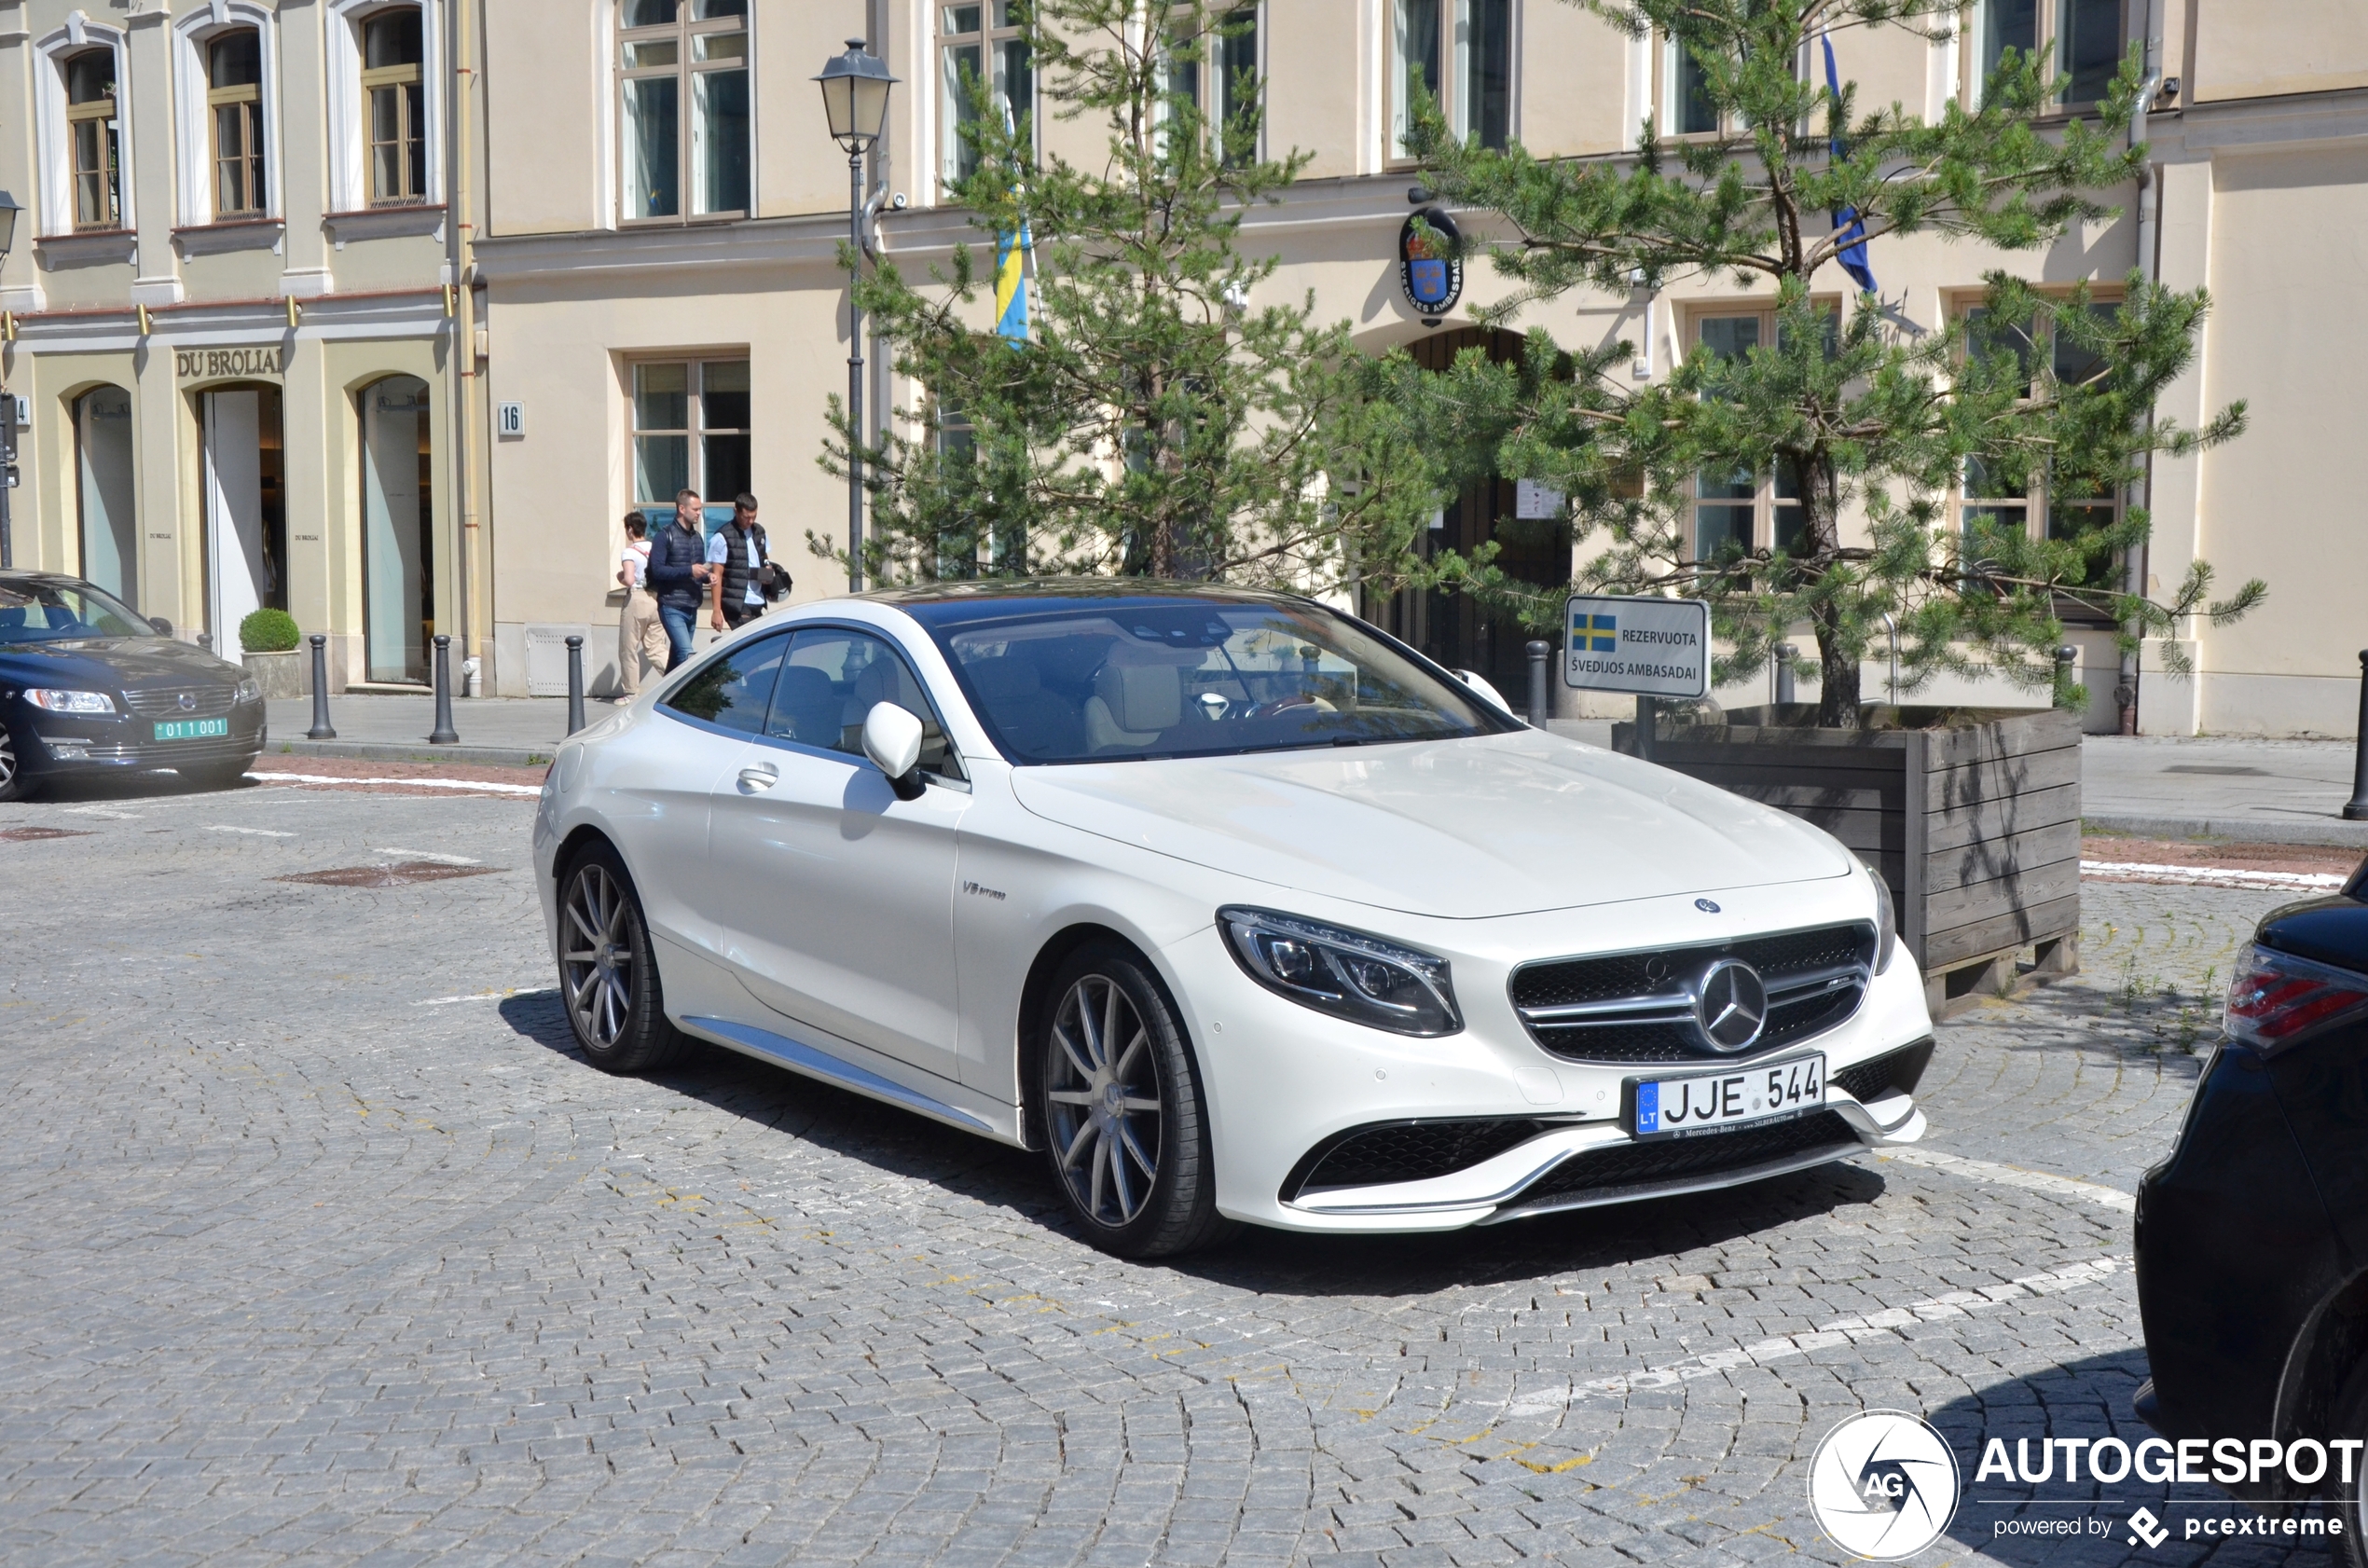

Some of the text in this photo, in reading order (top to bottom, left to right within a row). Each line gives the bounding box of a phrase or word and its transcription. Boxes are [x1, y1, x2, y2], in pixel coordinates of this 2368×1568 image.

[1400, 258, 1460, 312] SVERIGES AMBASSAD
[176, 348, 284, 378] DU BROLIAI
[503, 406, 518, 431] 16
[1622, 629, 1697, 646] REZERVUOTA
[1571, 656, 1696, 680] ŠVEDIJOS AMBASADAI
[166, 722, 182, 737] 01
[200, 719, 222, 735] 001
[1664, 1061, 1818, 1123] JJE 544
[1640, 1111, 1657, 1125] LT
[1685, 1124, 1736, 1137] Mercedes-Benz
